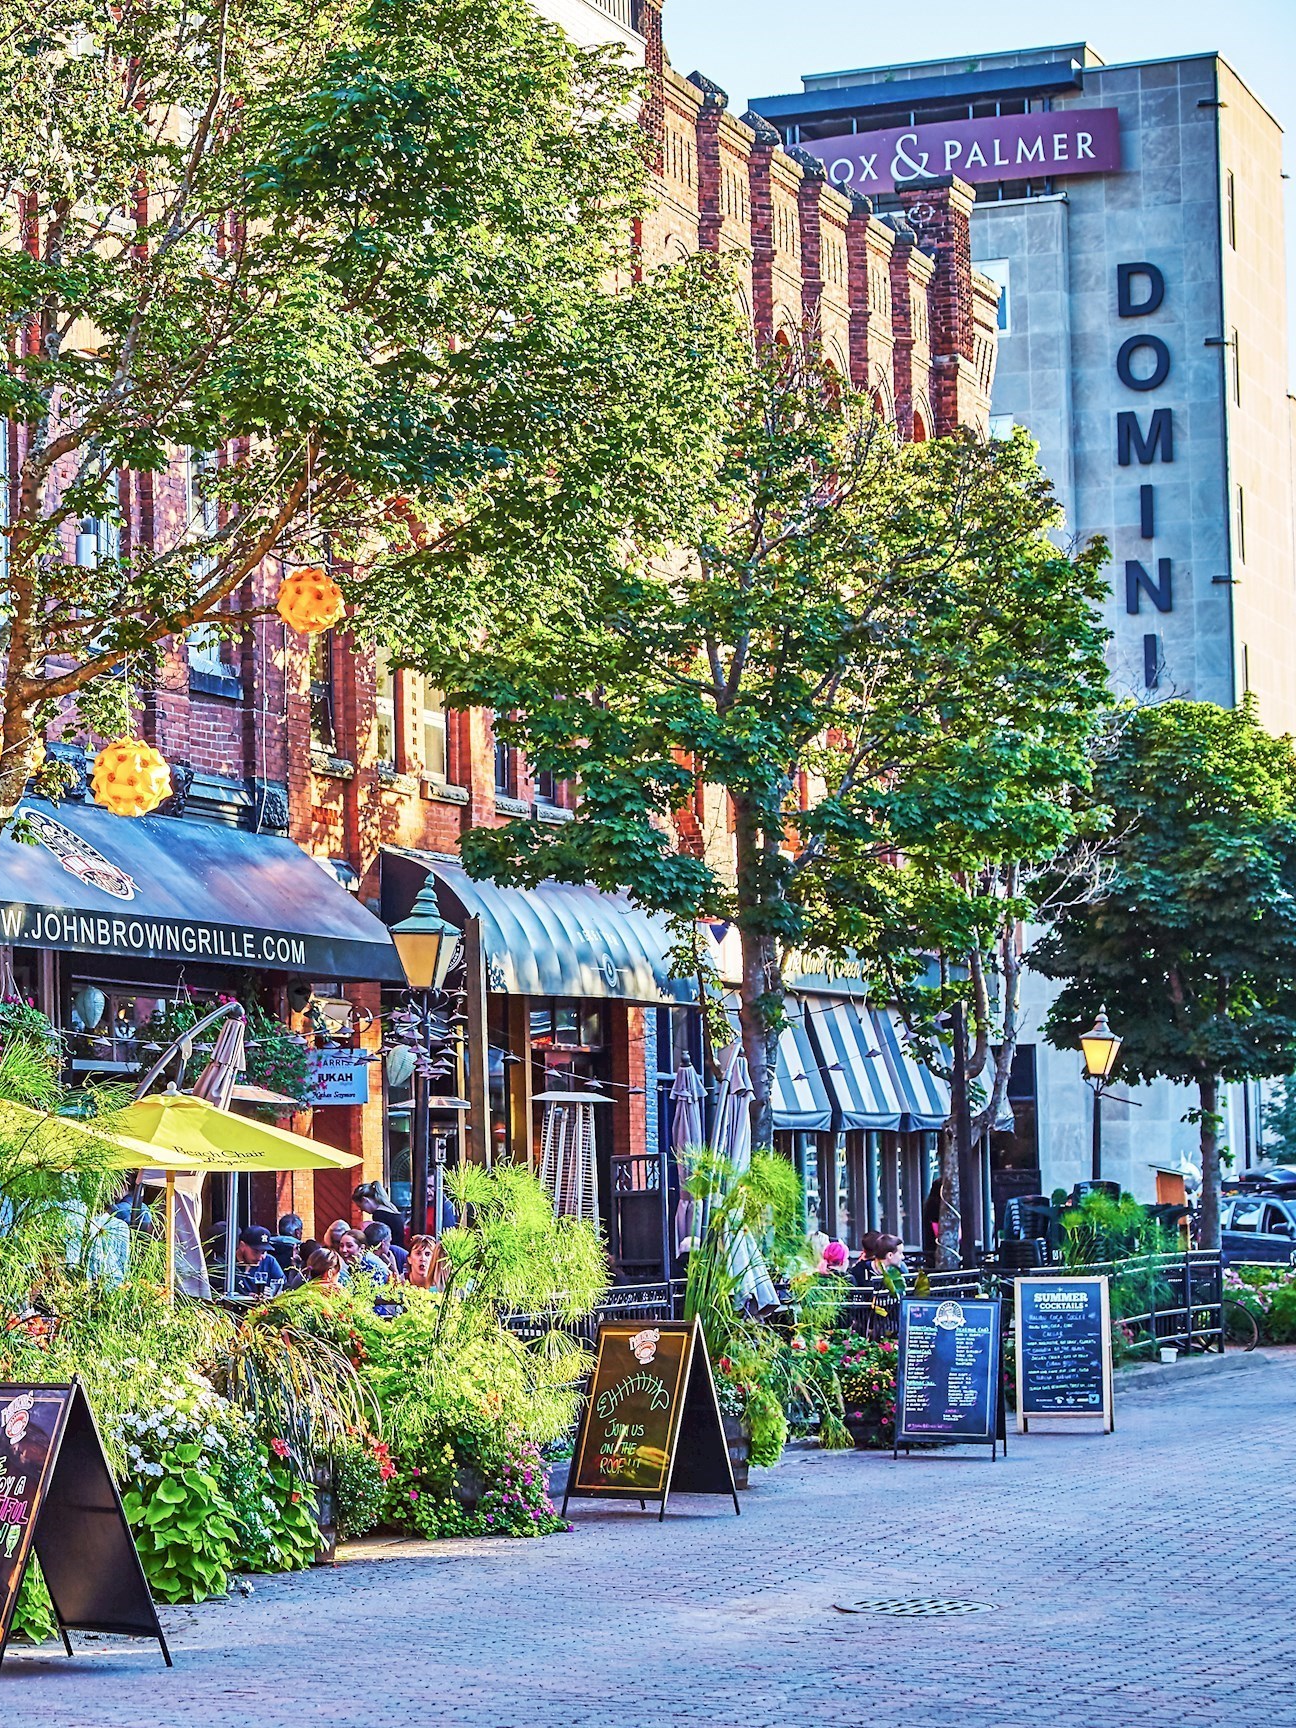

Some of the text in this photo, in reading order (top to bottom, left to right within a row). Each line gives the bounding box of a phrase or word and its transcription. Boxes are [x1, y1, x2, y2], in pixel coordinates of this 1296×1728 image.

[817, 132, 1096, 185] OX & PALMER
[172, 1145, 265, 1158] Beach Chair
[1034, 1292, 1089, 1303] SUMMER
[631, 1424, 646, 1437] US
[600, 1442, 638, 1456] ON THE
[14, 1476, 27, 1496] A
